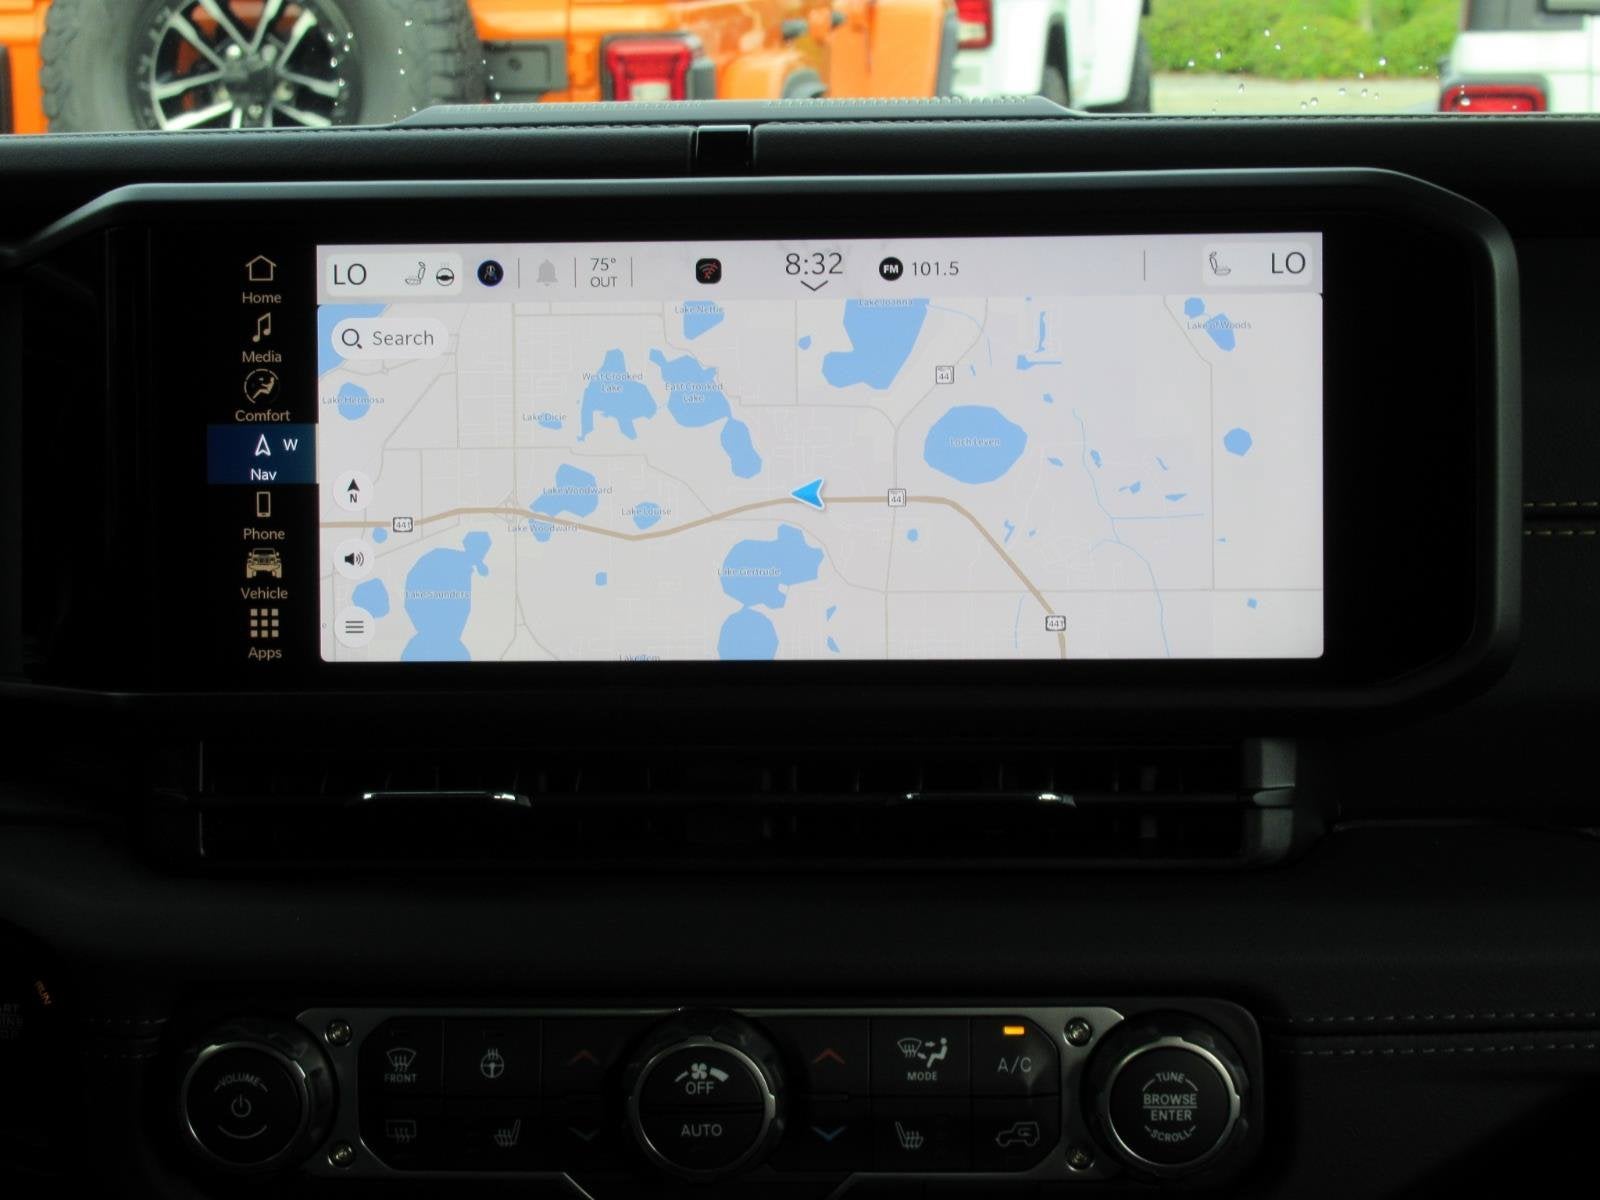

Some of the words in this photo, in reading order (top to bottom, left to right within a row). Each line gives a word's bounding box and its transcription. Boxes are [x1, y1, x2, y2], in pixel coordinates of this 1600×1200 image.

[785, 252, 843, 275] 8:32
[911, 261, 960, 276] 101.5
[1271, 251, 1306, 274] LO
[333, 263, 367, 285] LO
[883, 265, 899, 273] FM
[590, 276, 617, 288] OUT
[242, 292, 282, 304] Home
[675, 305, 693, 313] Lake
[1187, 321, 1207, 330] Lake
[372, 330, 434, 346] Search
[242, 351, 282, 363] Media
[235, 409, 291, 422] Comfort
[522, 412, 542, 421] Lake
[283, 438, 298, 451] W
[250, 468, 277, 481] Nav
[543, 486, 563, 494] Lake
[349, 494, 358, 503] N
[621, 507, 641, 516] Lake
[243, 528, 285, 540] Phone
[507, 524, 527, 532] Lake
[241, 587, 288, 599] Vehicle
[248, 647, 282, 659] Apps
[997, 1057, 1032, 1073] A/C
[220, 1072, 261, 1087] VOLUME
[384, 1073, 416, 1083] FRONT
[907, 1072, 938, 1081] MODE
[1155, 1072, 1185, 1083] TUNE
[685, 1081, 715, 1095] OFF
[1143, 1093, 1198, 1105] BROWSE
[1150, 1109, 1193, 1121] ENTER
[680, 1123, 723, 1137] AUTO
[1150, 1129, 1192, 1143] SCROLL
